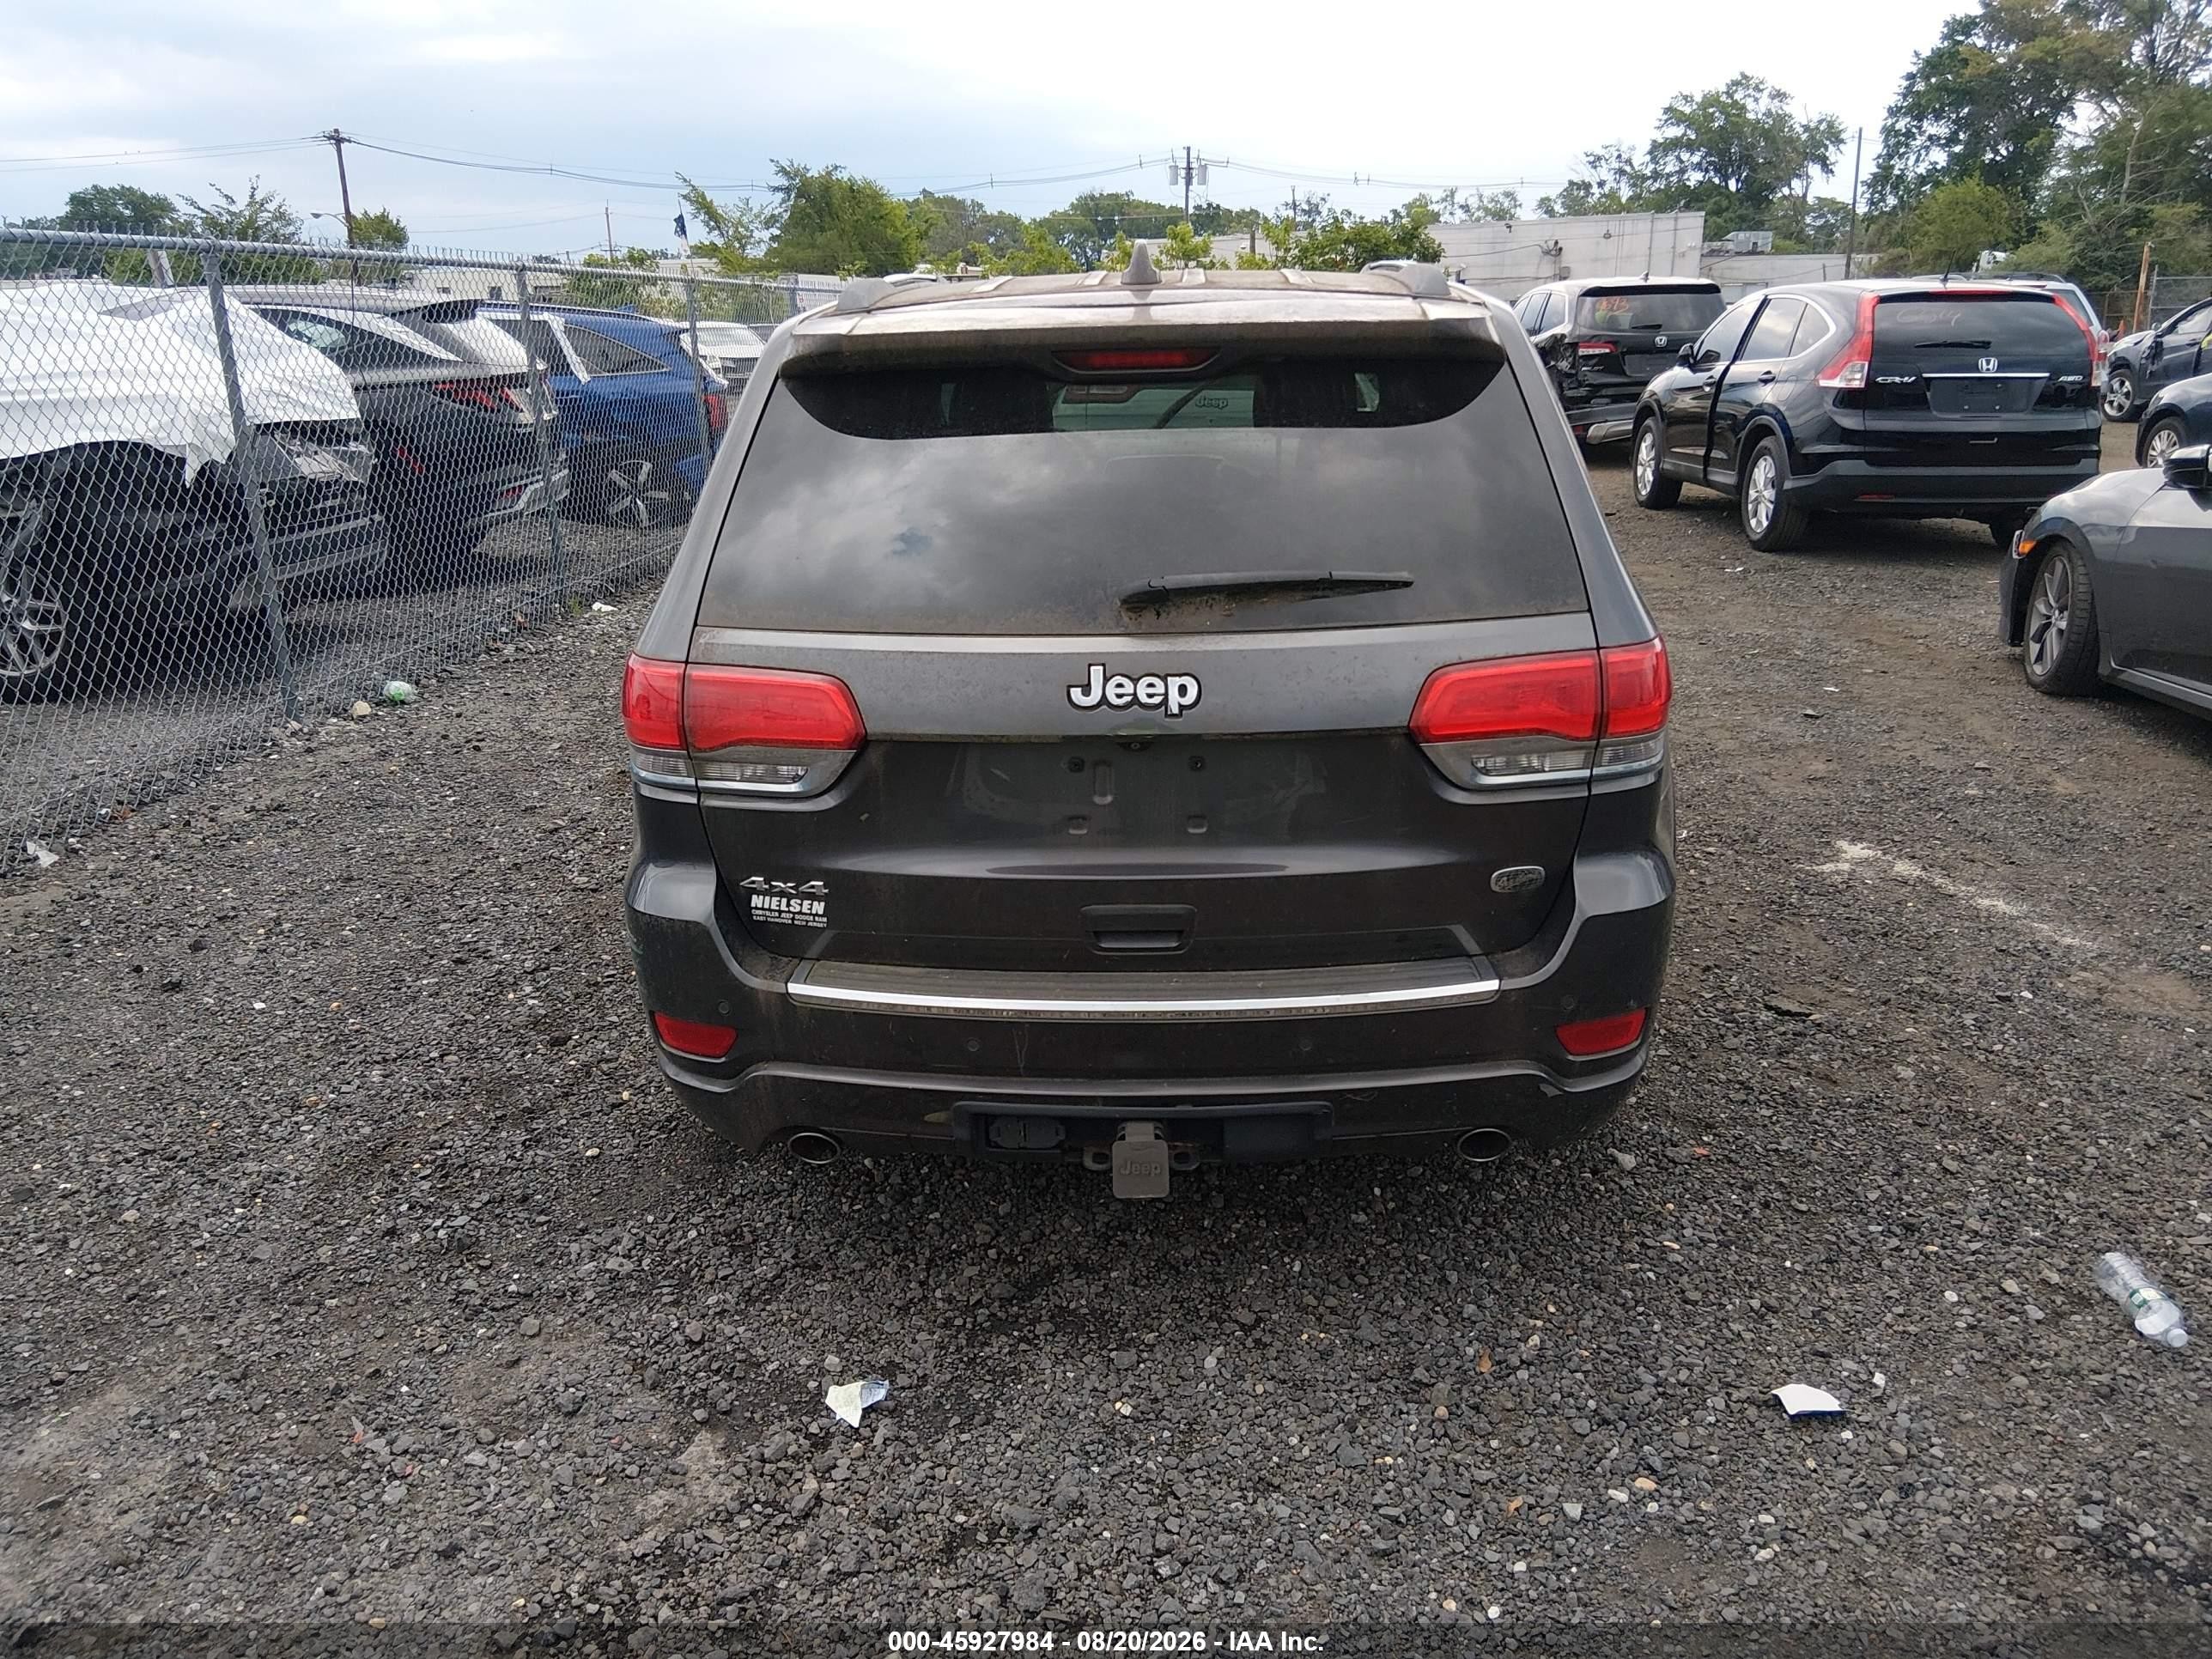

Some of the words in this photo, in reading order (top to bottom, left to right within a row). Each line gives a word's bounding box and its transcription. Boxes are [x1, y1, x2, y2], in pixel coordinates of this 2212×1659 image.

[1194, 393, 1229, 410] Jeep
[1067, 664, 1202, 718] Jeep
[750, 894, 825, 915] NIELSEN
[751, 908, 779, 917] CHRYSLER
[1119, 1160, 1162, 1177] Jeep
